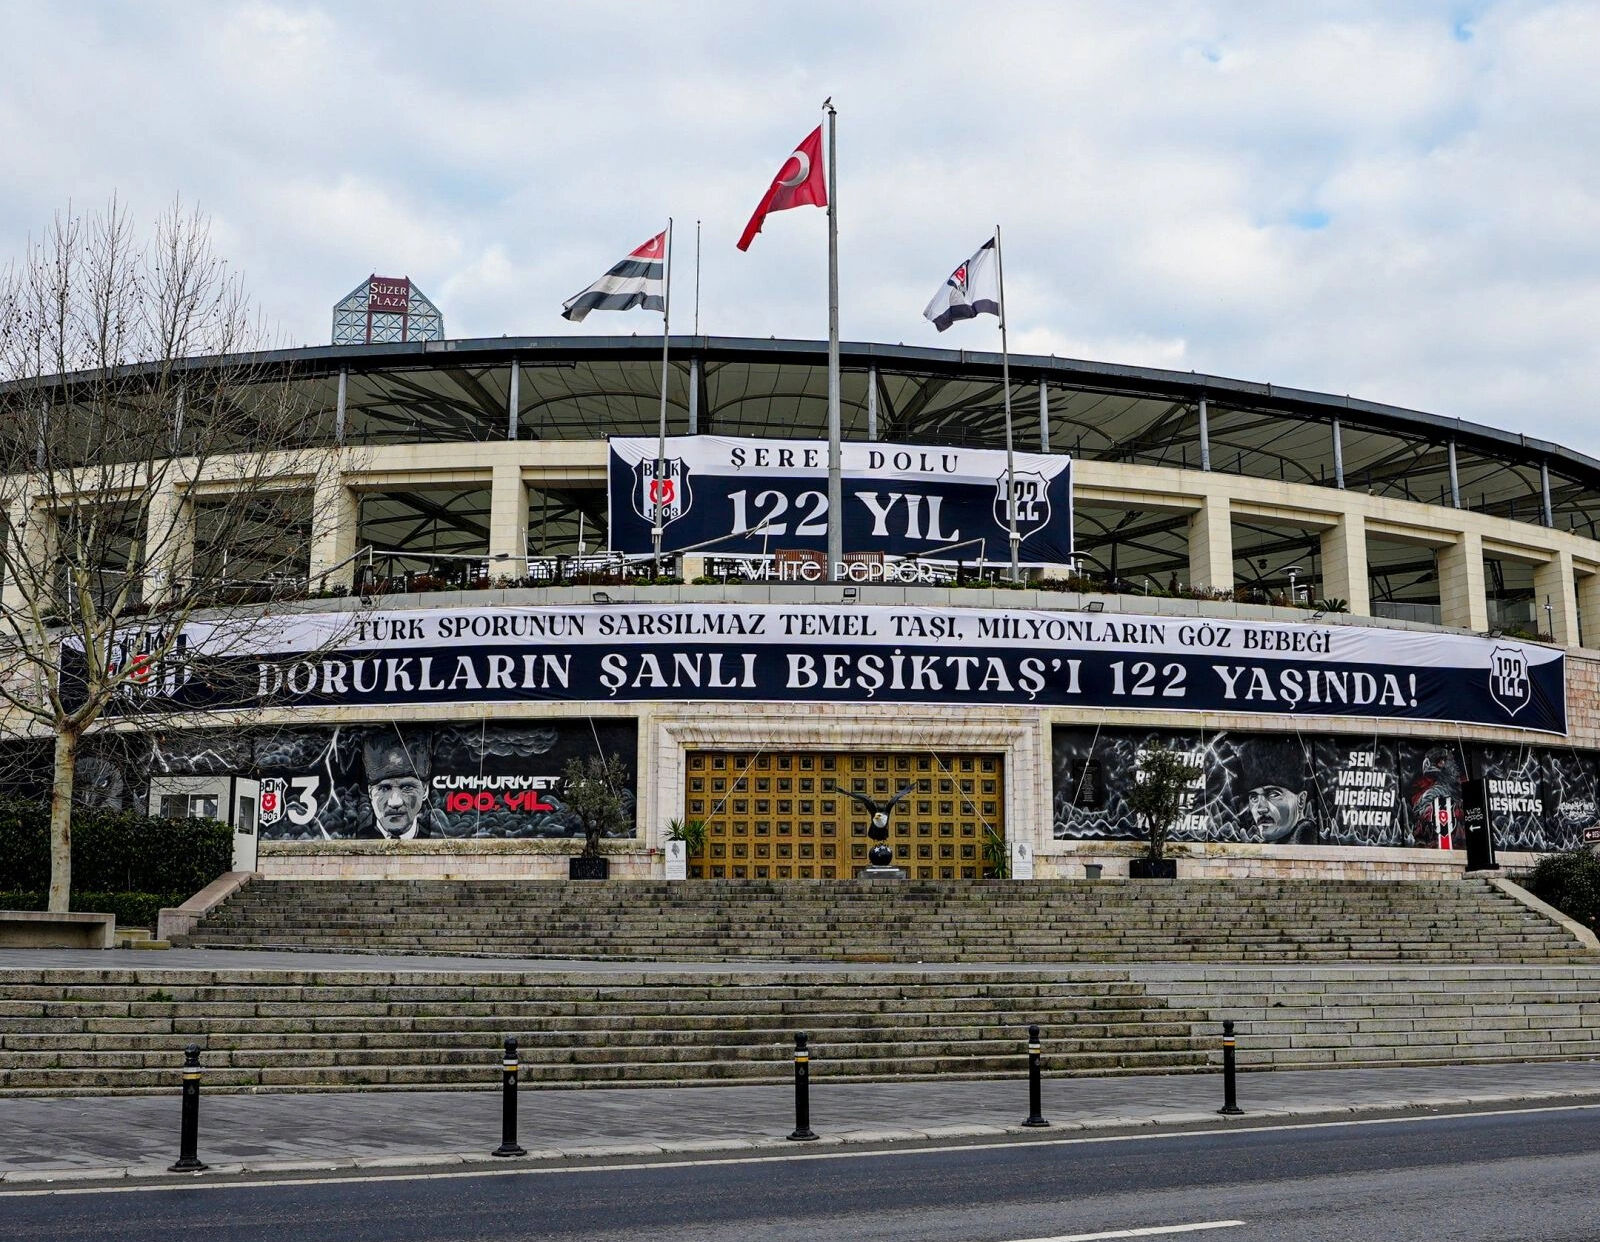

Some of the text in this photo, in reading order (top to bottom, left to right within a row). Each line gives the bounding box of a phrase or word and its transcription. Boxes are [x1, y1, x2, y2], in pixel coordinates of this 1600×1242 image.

[370, 282, 407, 295] SÜZER
[369, 294, 407, 307] PLAZA
[731, 447, 958, 473] ŞERE DOLU
[1005, 480, 1039, 521] 122
[648, 507, 679, 517] 103
[727, 489, 960, 542] 122 YIL
[354, 613, 1333, 653] TÜRK SPORUNUN SARSILMAZ TEMEL TAŞI, MİLYONLARIN GÖZ BEBEĞİ
[256, 653, 571, 697] DORUKLARIN
[599, 653, 757, 697] ŞANLI
[1110, 660, 1187, 697] 122
[1211, 665, 1418, 709] YAŞINDA!
[1497, 656, 1523, 698] 122
[1348, 751, 1375, 768] SEN
[1338, 770, 1387, 787] VARDIN
[1488, 779, 1535, 795] BURASI
[503, 790, 554, 812] YIL
[1341, 809, 1392, 827] YOKKEN
